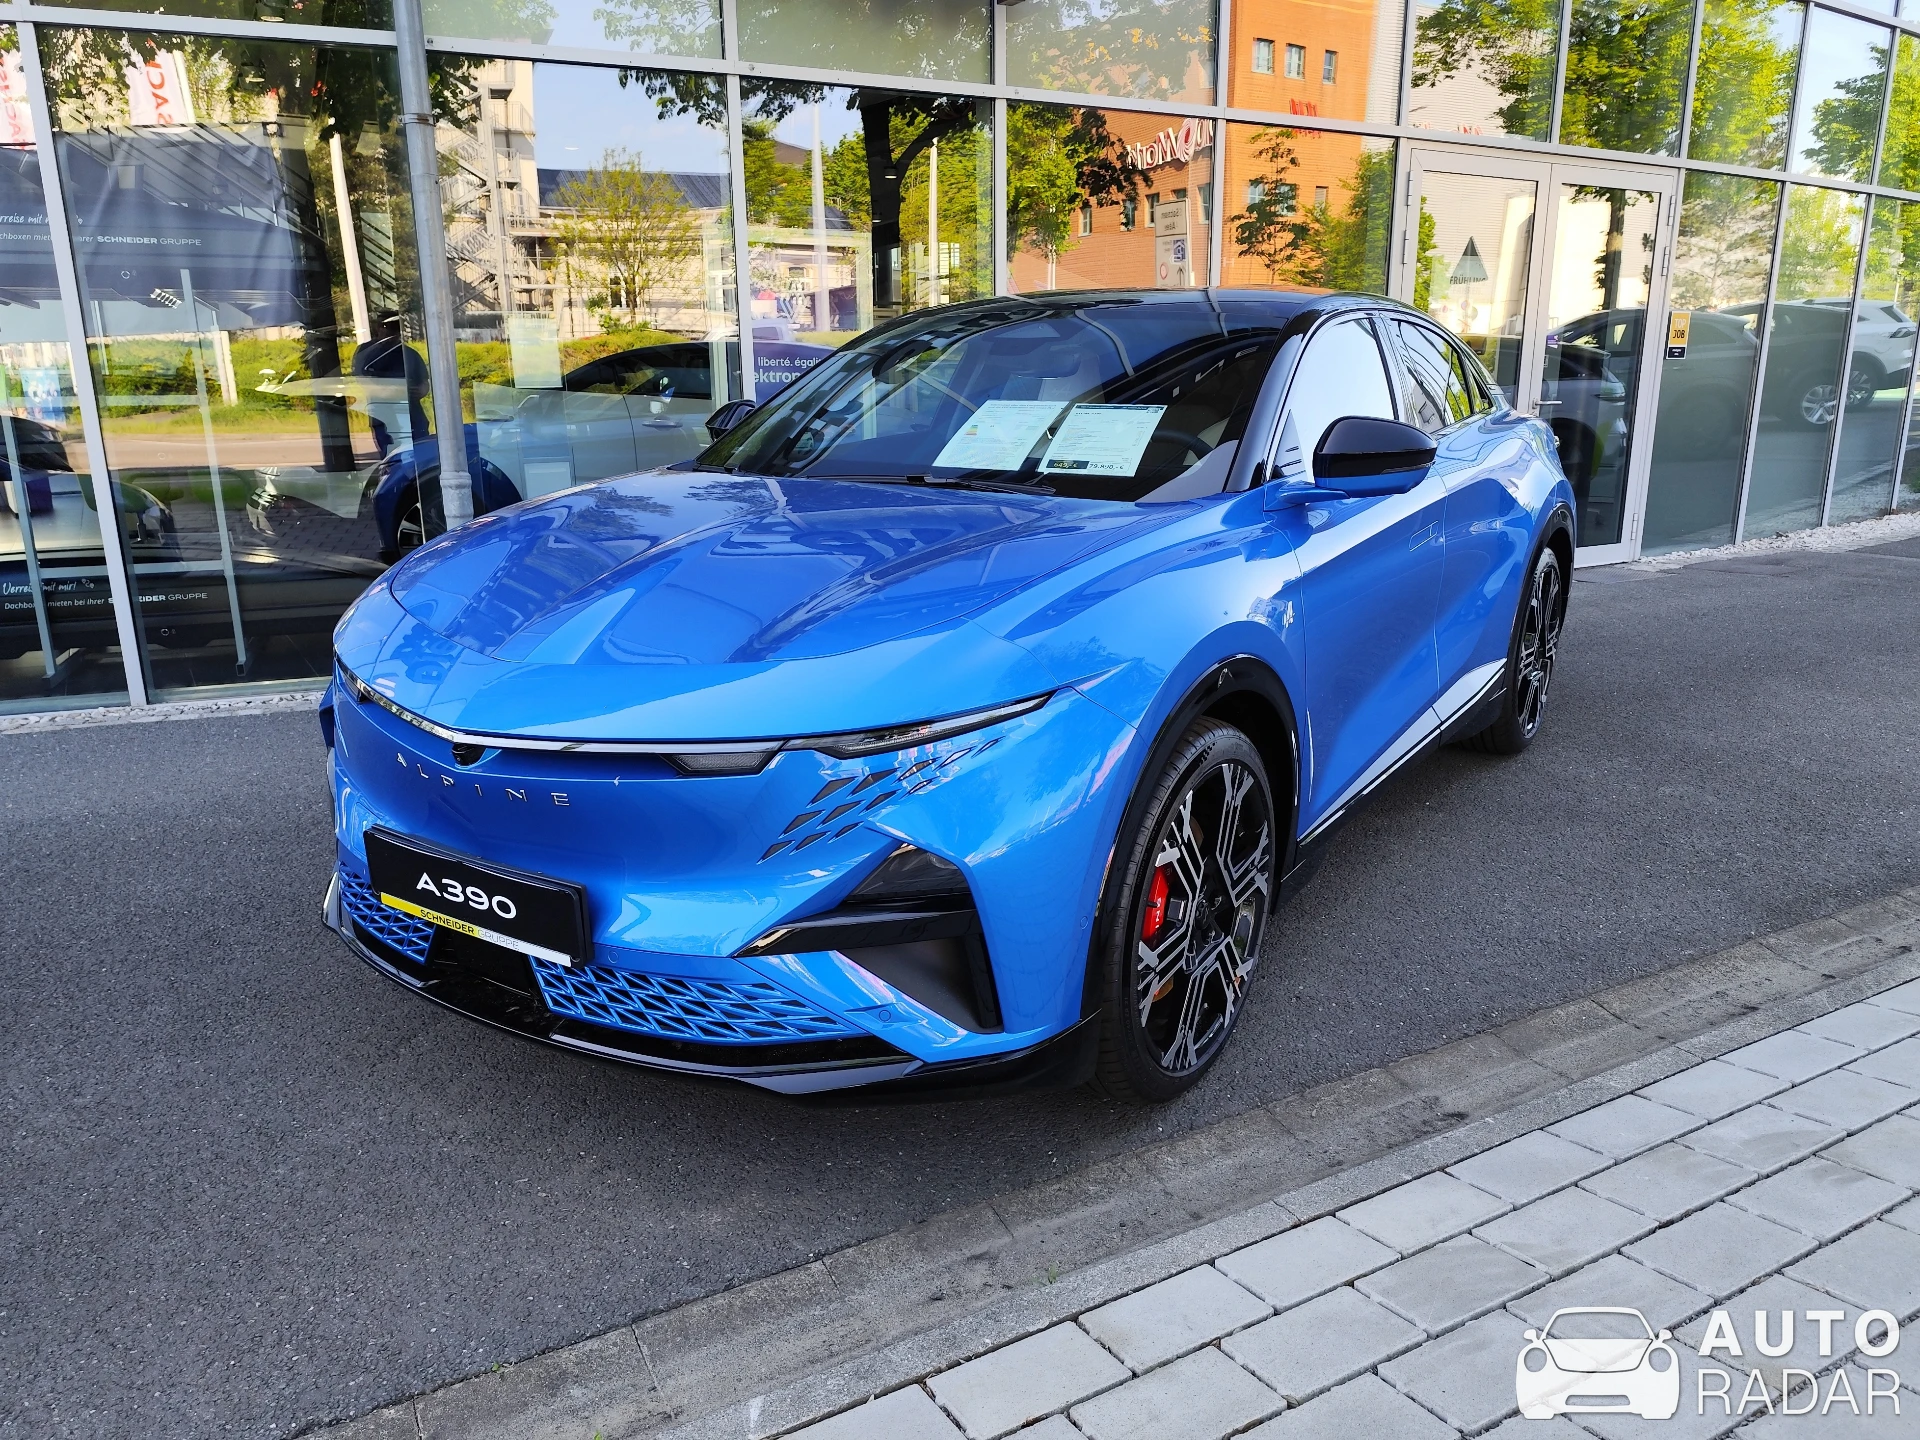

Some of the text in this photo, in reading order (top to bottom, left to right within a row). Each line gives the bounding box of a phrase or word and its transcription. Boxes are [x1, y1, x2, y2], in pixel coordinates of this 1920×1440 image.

[0, 213, 24, 223] rreise
[0, 232, 31, 241] chboxen
[97, 235, 158, 244] SCHNEIDER
[160, 237, 202, 246] GRUPPE
[1674, 318, 1687, 328] TOP
[1672, 329, 1686, 339] JOB
[758, 356, 822, 368] liberté. égali
[74, 598, 86, 606] bei
[168, 592, 208, 601] GRUPPE
[397, 752, 571, 807] ALPINE
[416, 872, 517, 919] A390
[420, 909, 520, 951] SCHNEIDER GRUPPE
